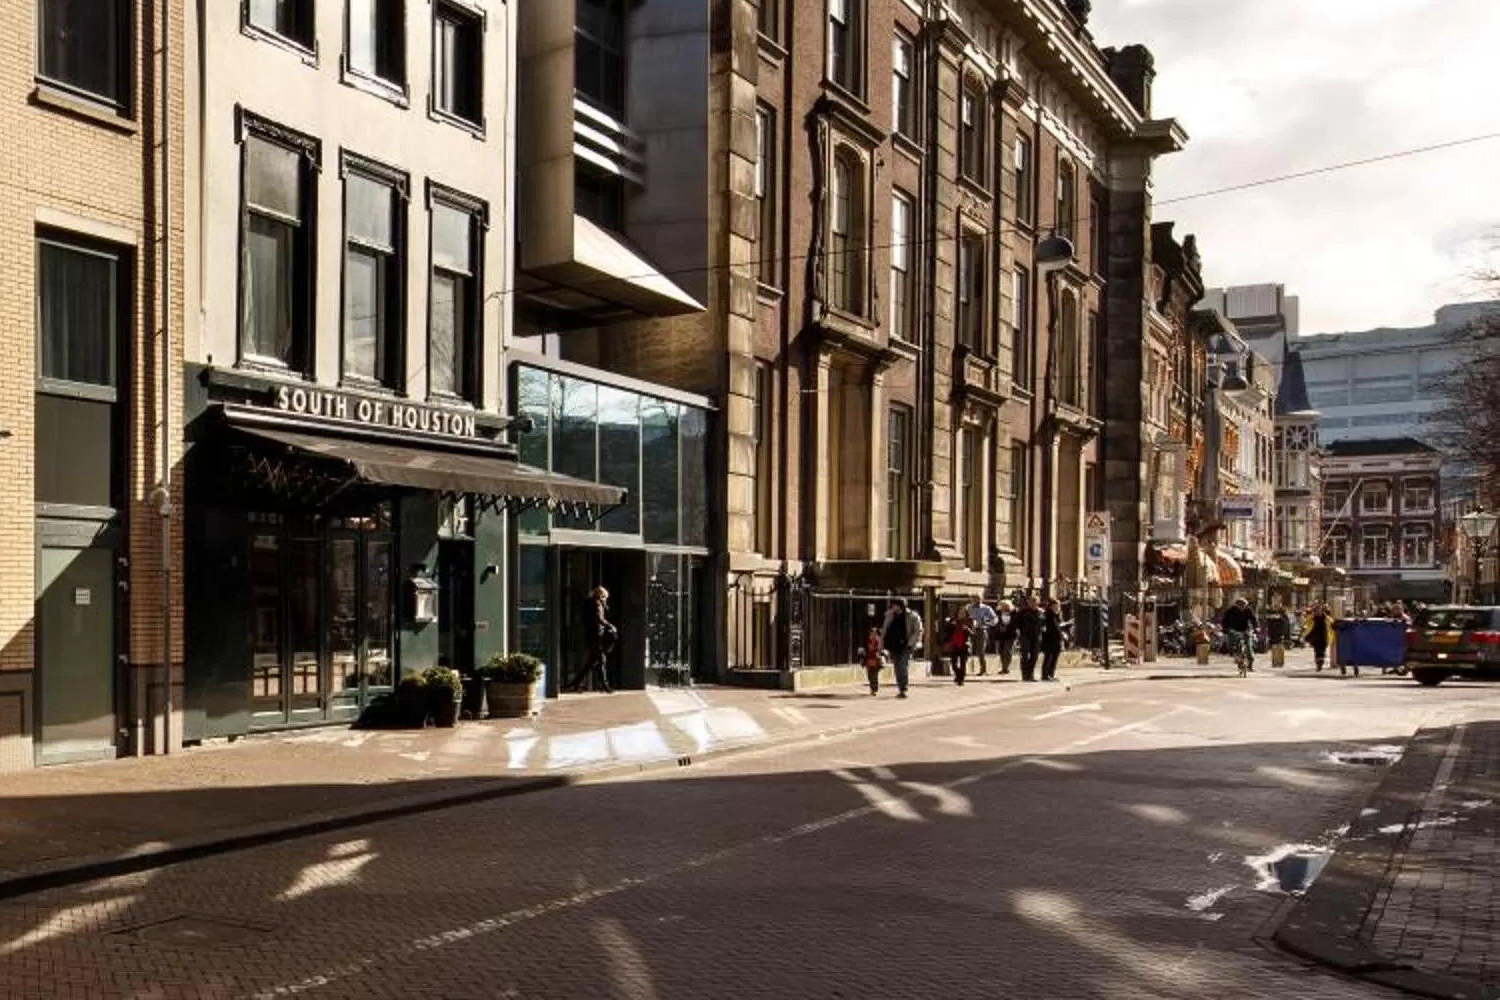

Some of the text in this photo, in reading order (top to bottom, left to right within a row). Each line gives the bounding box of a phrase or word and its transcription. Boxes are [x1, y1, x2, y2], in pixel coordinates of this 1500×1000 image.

[279, 386, 476, 438] SOUTH OF HOUSTON
